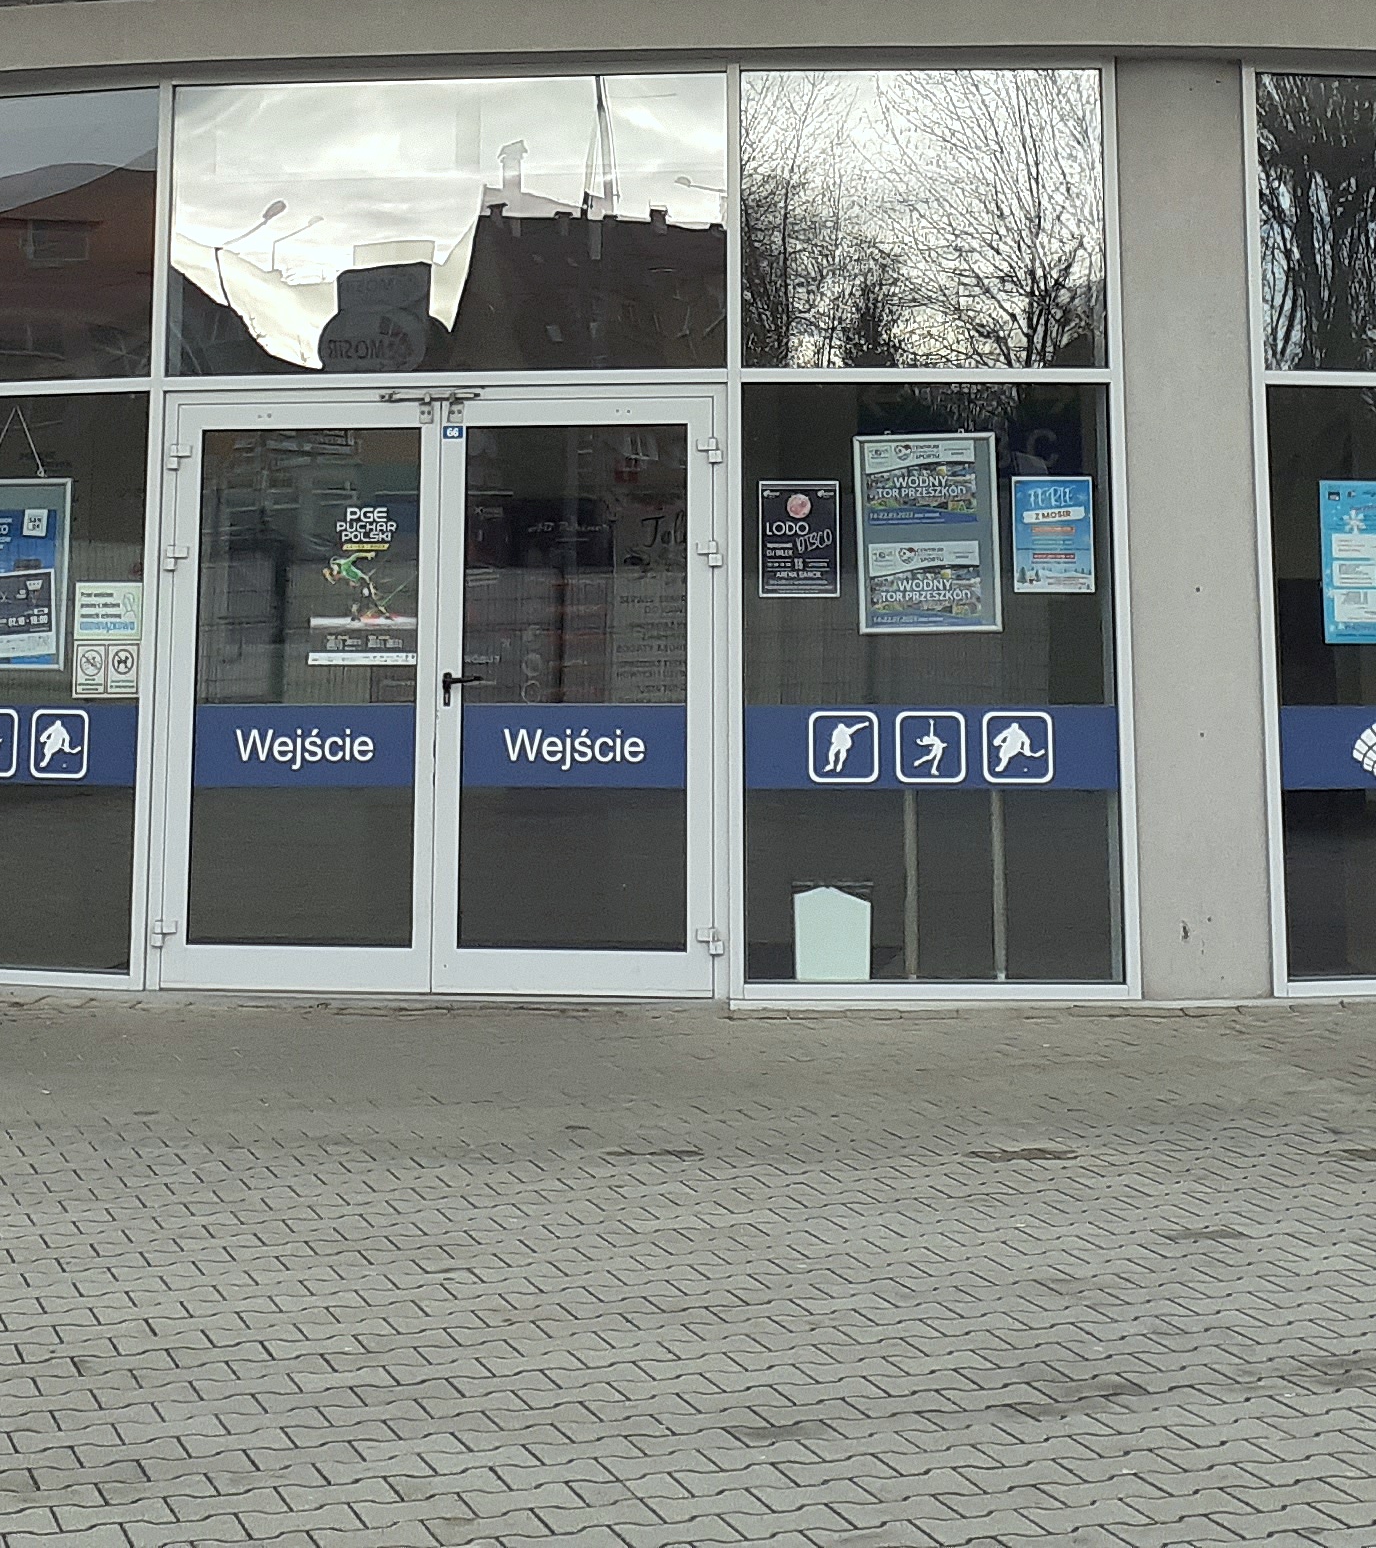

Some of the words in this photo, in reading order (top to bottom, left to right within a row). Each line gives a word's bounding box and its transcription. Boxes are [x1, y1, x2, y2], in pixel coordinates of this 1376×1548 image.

[446, 427, 459, 438] 66
[893, 475, 948, 488] WODNY
[876, 488, 899, 499] TOR
[346, 507, 388, 522] PGE
[1034, 512, 1041, 521] Z
[336, 521, 397, 533] PUCHAR
[766, 521, 809, 535] LODO
[341, 531, 392, 542] POLSKI
[795, 528, 833, 554] DISCO
[898, 579, 953, 591] WODNY
[881, 592, 903, 602] TOR
[236, 728, 375, 770] Wejście
[504, 728, 646, 771] Wejście
